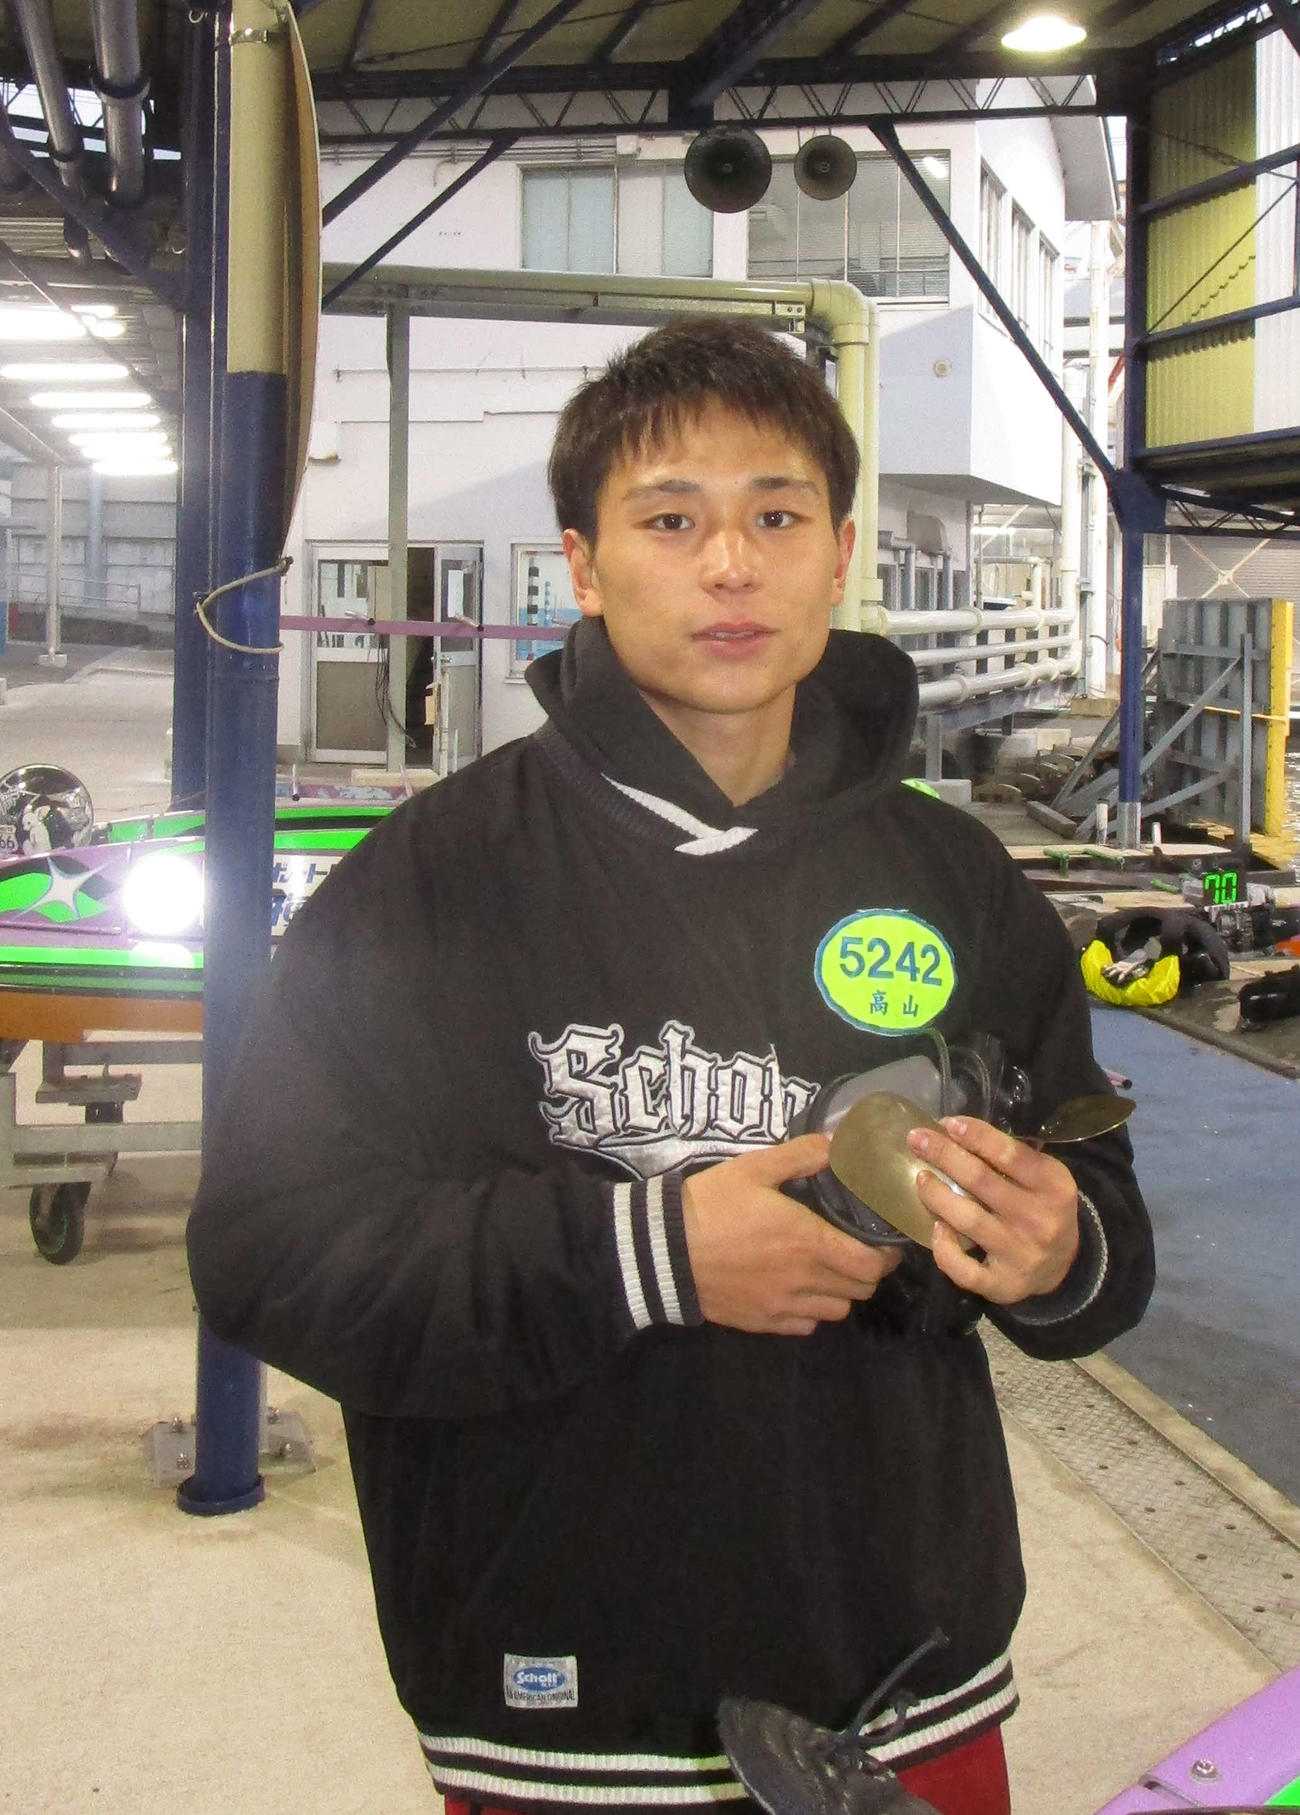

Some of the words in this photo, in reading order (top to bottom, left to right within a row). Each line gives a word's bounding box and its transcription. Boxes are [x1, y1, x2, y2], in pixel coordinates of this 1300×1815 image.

[1204, 872, 1238, 905] 70
[839, 936, 943, 987] 5242
[870, 990, 919, 1017] 高山
